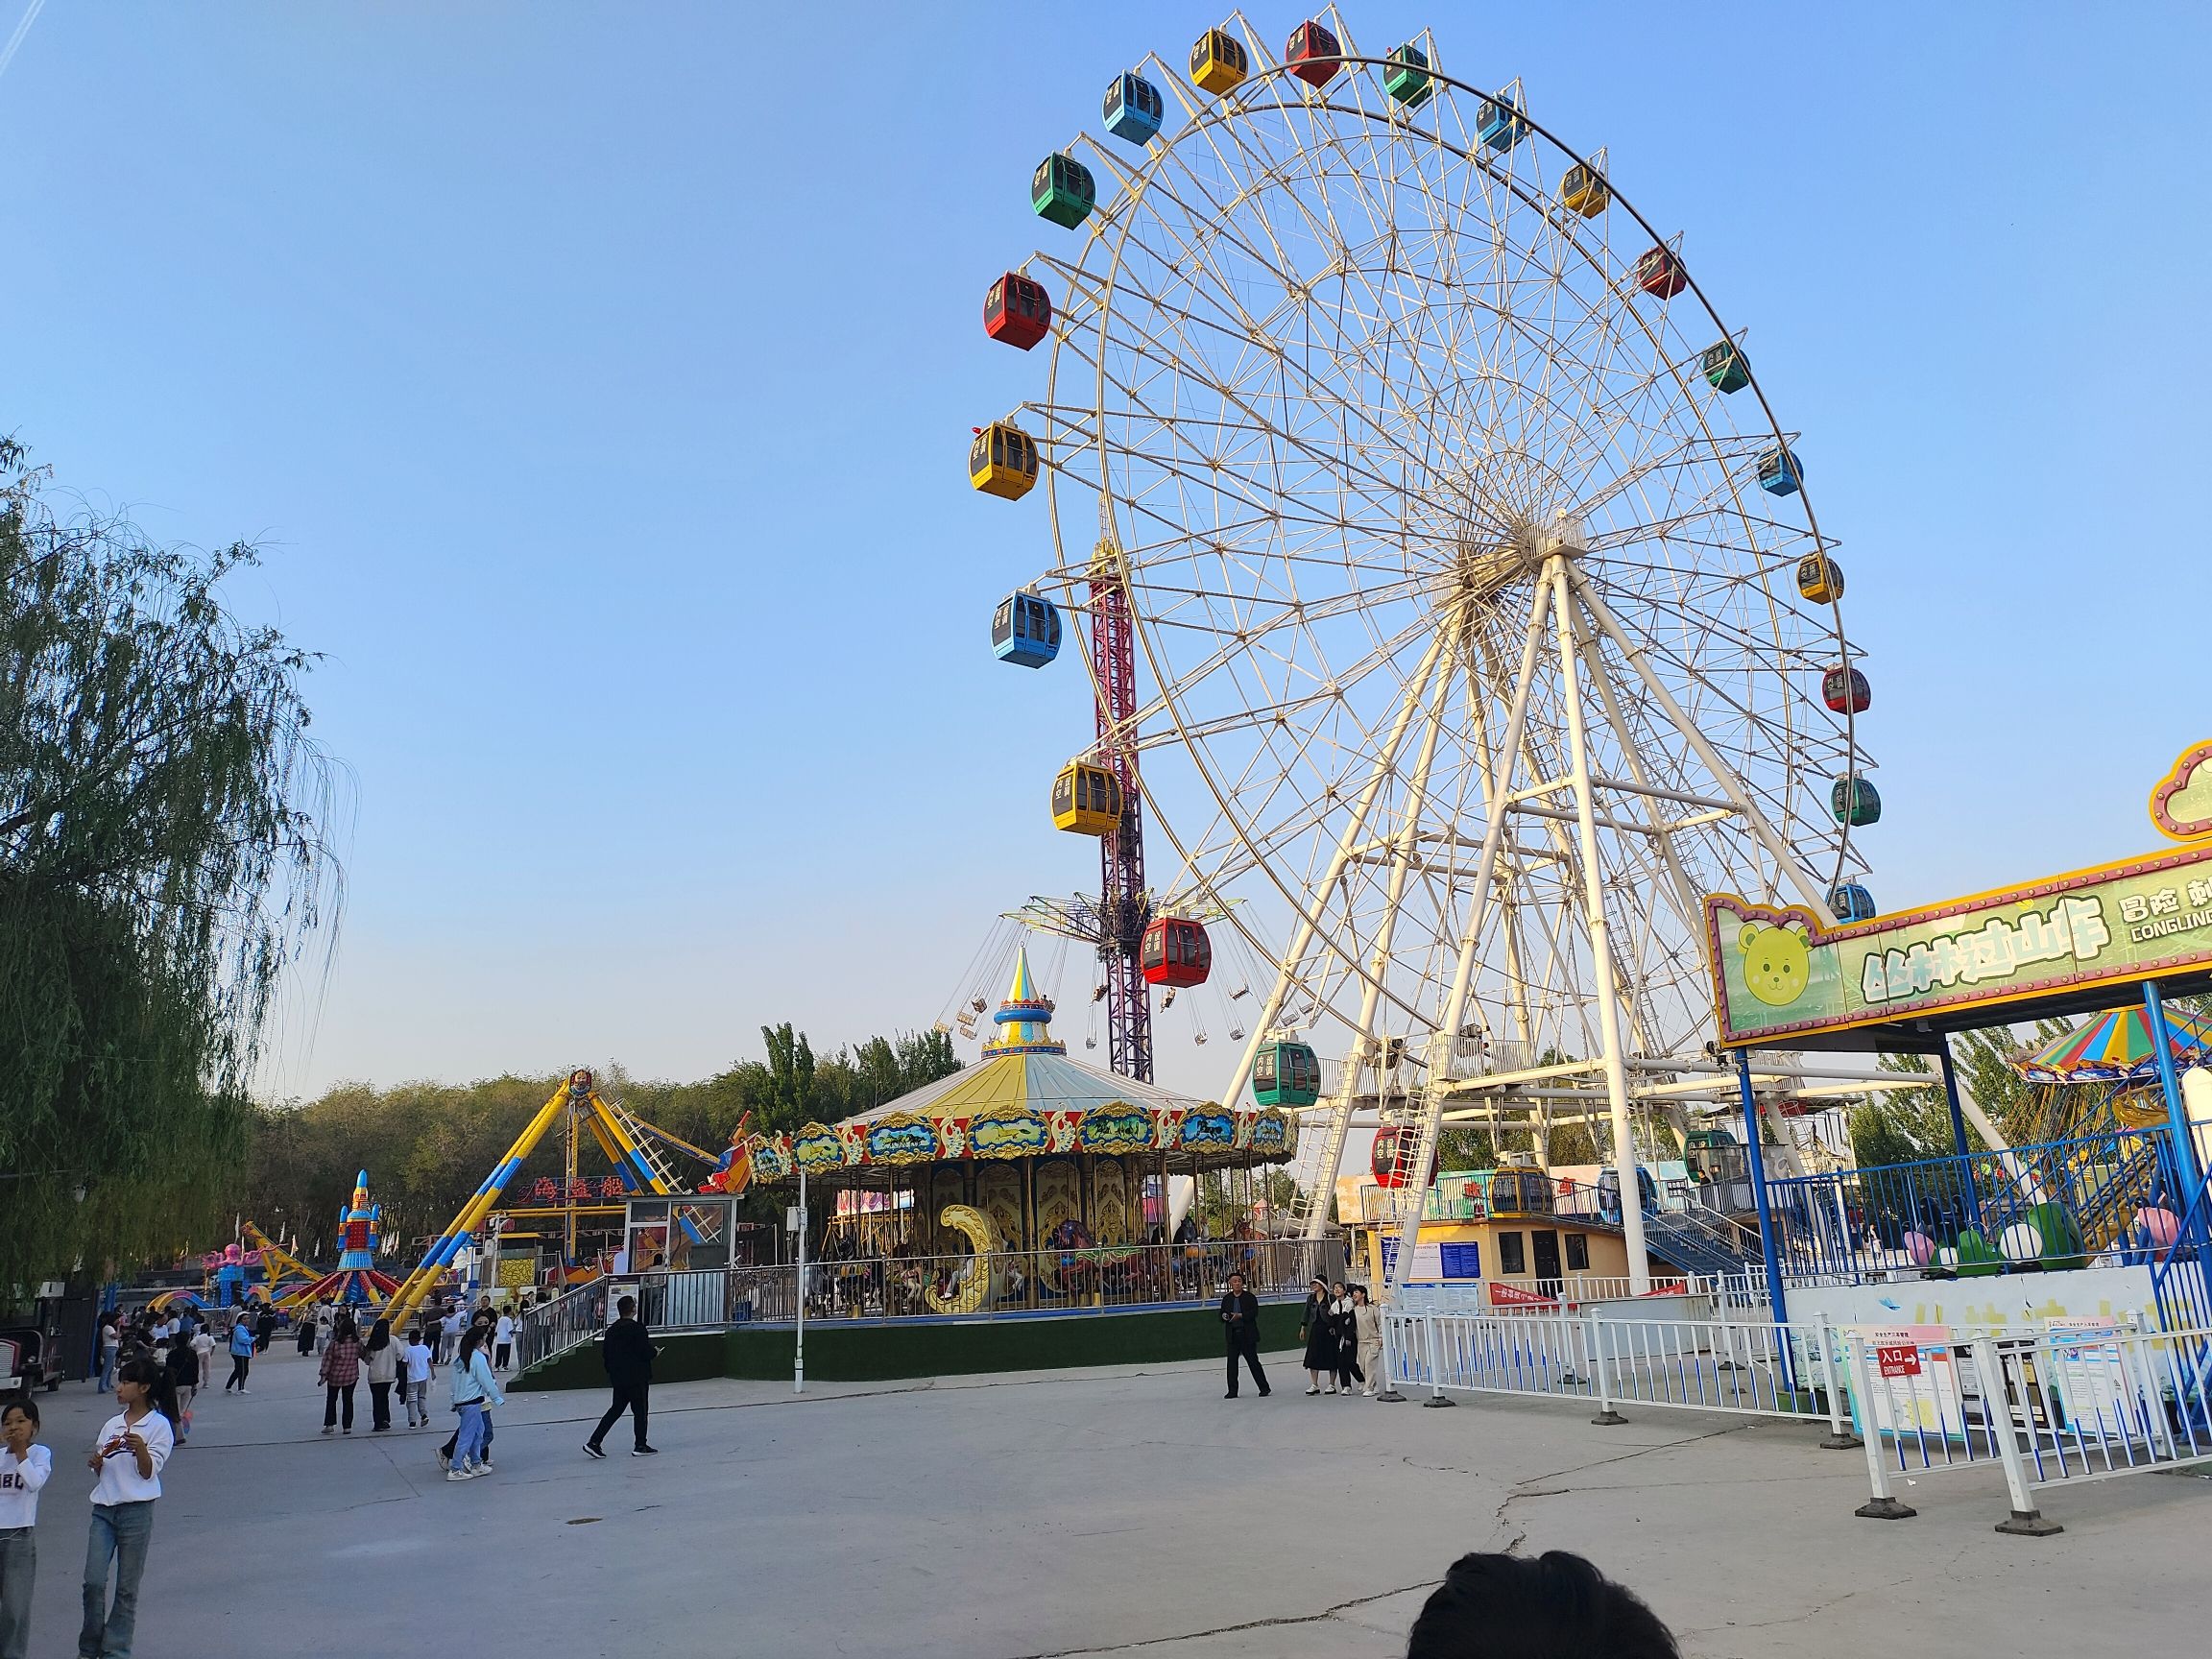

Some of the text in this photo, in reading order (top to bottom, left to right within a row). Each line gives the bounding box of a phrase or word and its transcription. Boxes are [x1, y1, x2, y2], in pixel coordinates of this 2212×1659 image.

[2119, 888, 2180, 923] 冒险
[1863, 897, 2108, 1001] 丛林过山车
[1882, 1349, 1903, 1363] 入口
[1884, 1364, 1906, 1376] ENTRANCE
